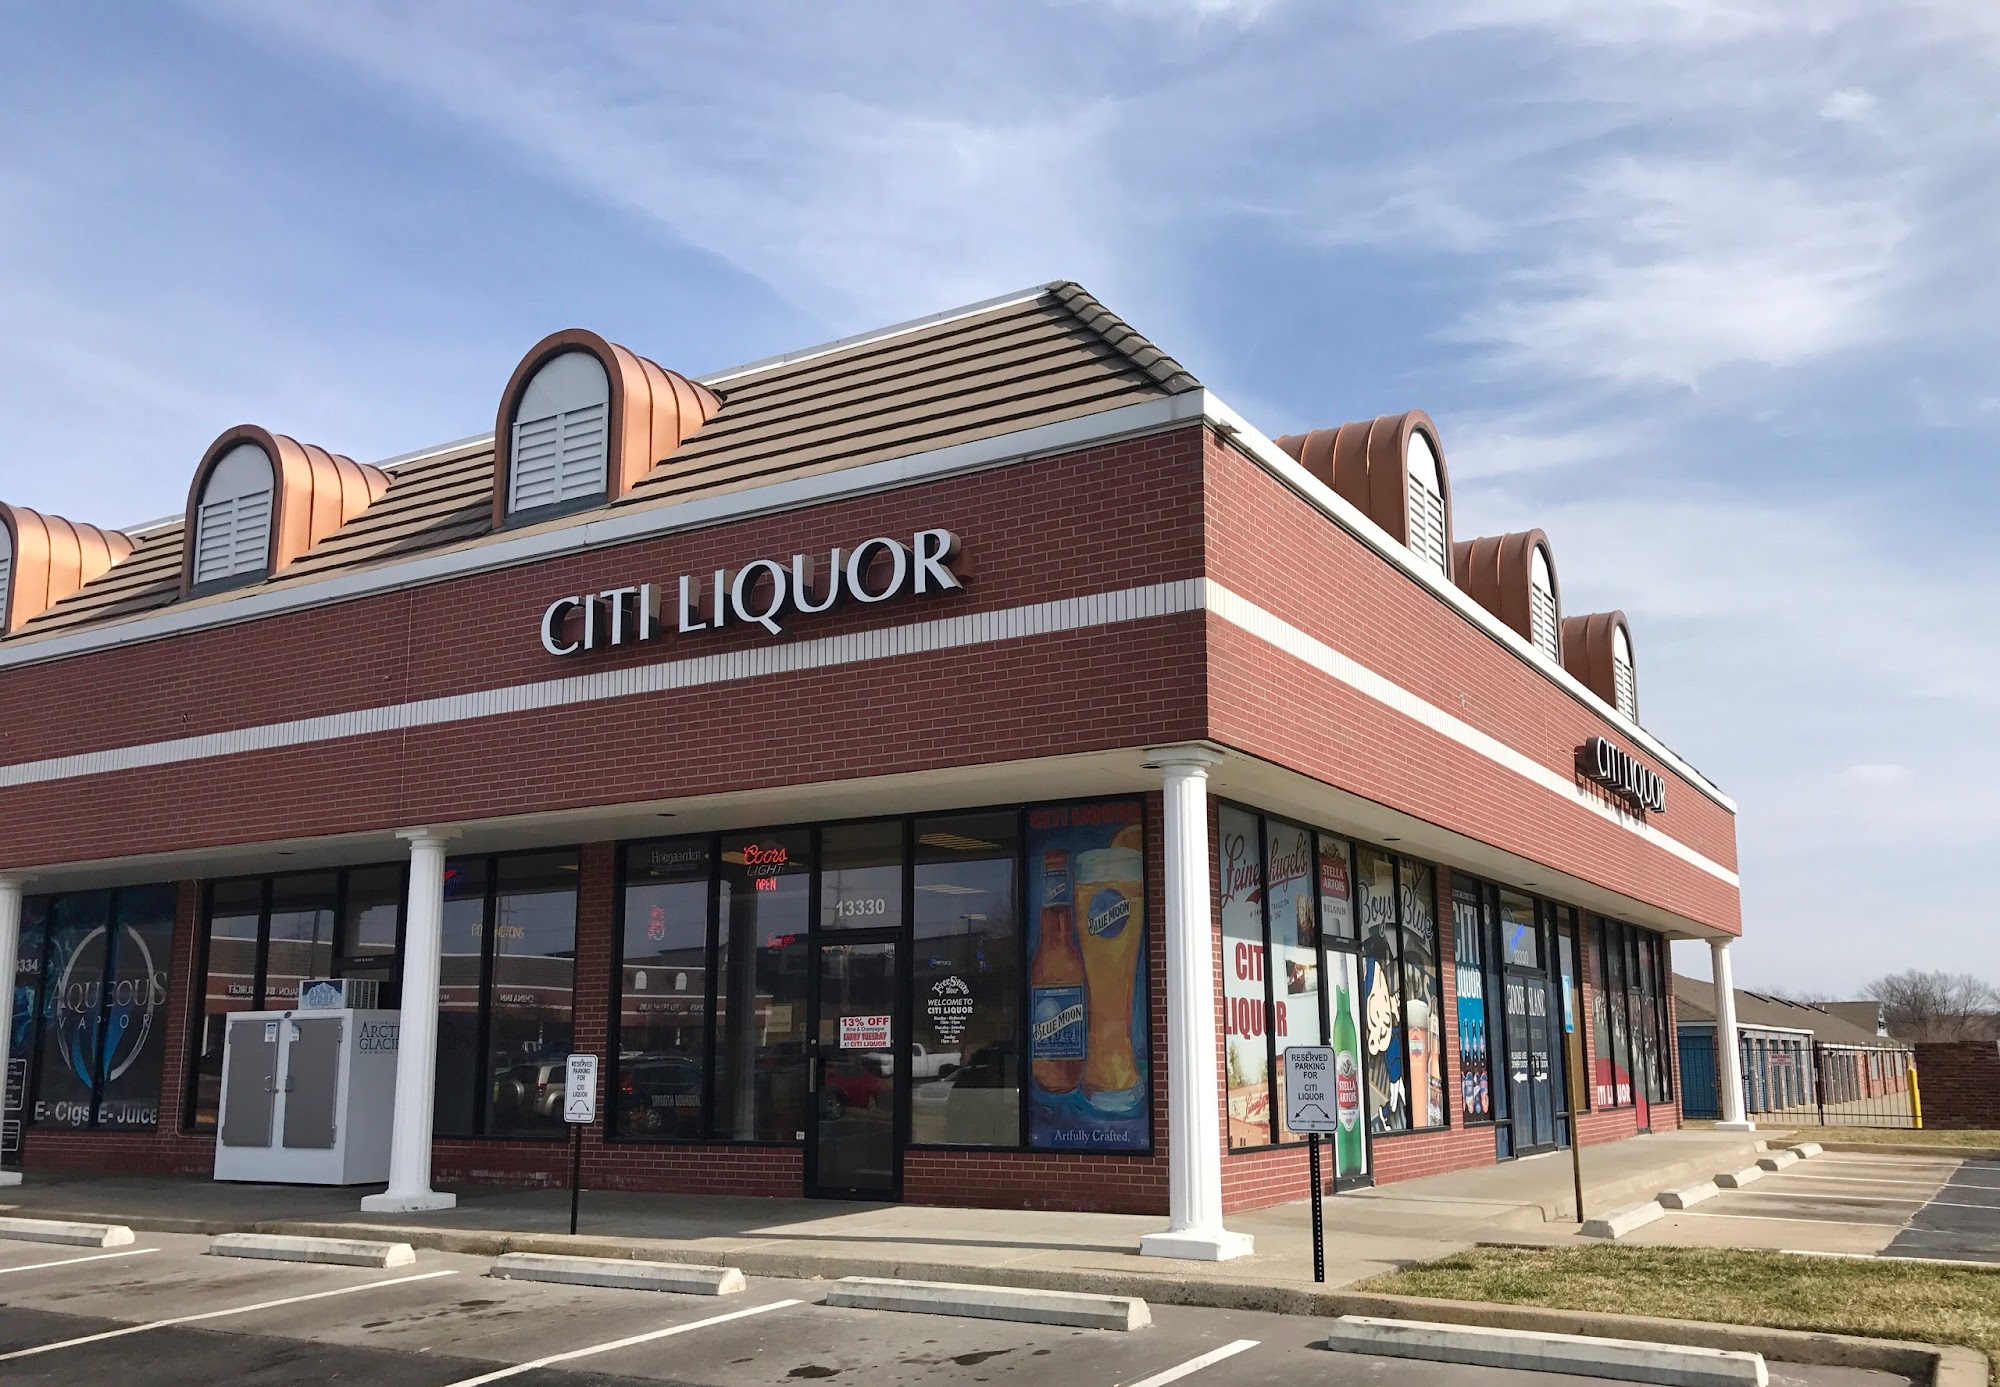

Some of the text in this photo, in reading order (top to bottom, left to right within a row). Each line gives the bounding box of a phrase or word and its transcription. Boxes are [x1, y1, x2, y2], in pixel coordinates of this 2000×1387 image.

[540, 528, 963, 656] CITI LIQUOR
[1597, 736, 1666, 813] CITI LIQUOR
[651, 848, 701, 865] Hoegaarden
[743, 844, 788, 865] Coors
[747, 863, 784, 877] LIGHT
[1221, 832, 1307, 909] Leinekugel's
[1322, 864, 1344, 879] STELLA
[755, 877, 777, 891] OPEN
[1323, 877, 1345, 892] ARTOIS
[836, 898, 885, 917] 13330
[1323, 903, 1347, 917] BELGIUM
[1400, 883, 1434, 940] Blue
[1088, 900, 1130, 936] BLUE MOON
[1235, 941, 1264, 982] CIT
[927, 998, 963, 1006] WELCOME
[1506, 984, 1526, 1015] GOOSE
[1528, 987, 1546, 1017] SLAND
[943, 1006, 974, 1014] LIQUOR
[841, 1016, 889, 1027] 13% OFF
[1033, 1006, 1082, 1042] BLUE MOON
[359, 1021, 400, 1038] ARCTI
[843, 1032, 887, 1041] EVERY TUESDAY
[359, 1038, 399, 1050] GLACIE
[1291, 1053, 1328, 1061] RESERVED
[1303, 1071, 1318, 1079] FOR
[1304, 1084, 1318, 1092] CITI
[1339, 1080, 1356, 1091] STELLA
[1298, 1092, 1324, 1101] LIQUOR
[1340, 1091, 1357, 1103] ARTOIS
[1597, 1083, 1631, 1105] ITI LIUOR
[55, 1101, 90, 1127] Cigs
[117, 1104, 157, 1125] Juice
[1055, 1129, 1090, 1144] Artfully
